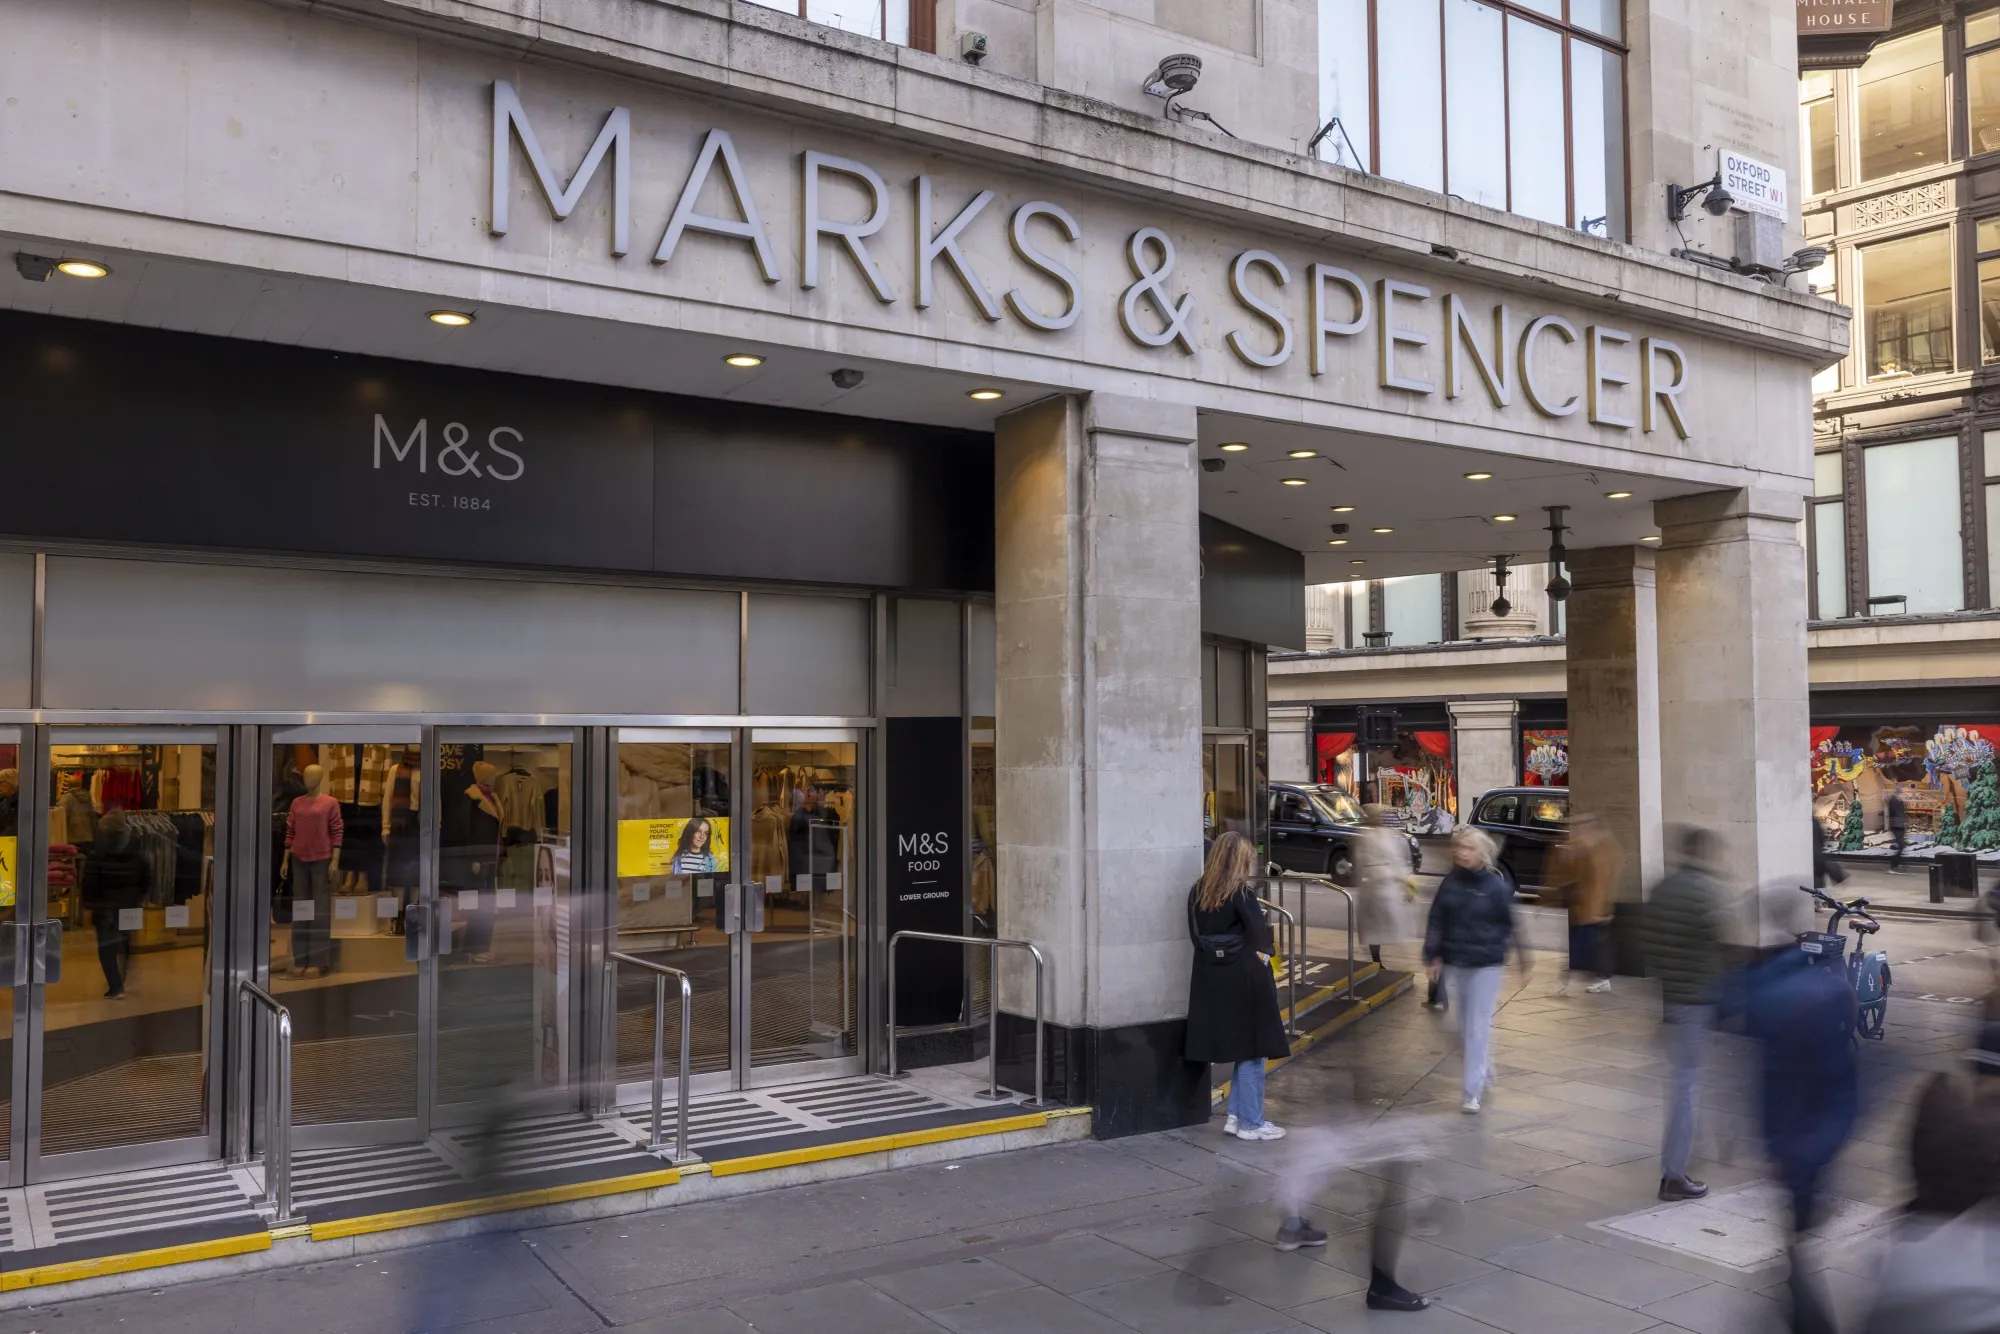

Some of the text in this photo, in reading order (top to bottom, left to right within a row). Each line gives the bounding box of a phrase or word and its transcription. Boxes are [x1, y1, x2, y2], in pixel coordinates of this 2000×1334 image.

[1807, 13, 1871, 26] HOUSE
[1727, 156, 1771, 182] OXFORD
[1728, 173, 1783, 205] STREET W1
[489, 78, 1692, 440] MARKS & SPENCER
[373, 413, 525, 481] M&S
[409, 492, 491, 511] EST. 1884
[439, 744, 465, 756] OVE
[439, 758, 464, 770] OSY
[898, 831, 949, 857] M&S
[908, 860, 940, 872] FOOD
[900, 891, 950, 901] LOWER GROUND
